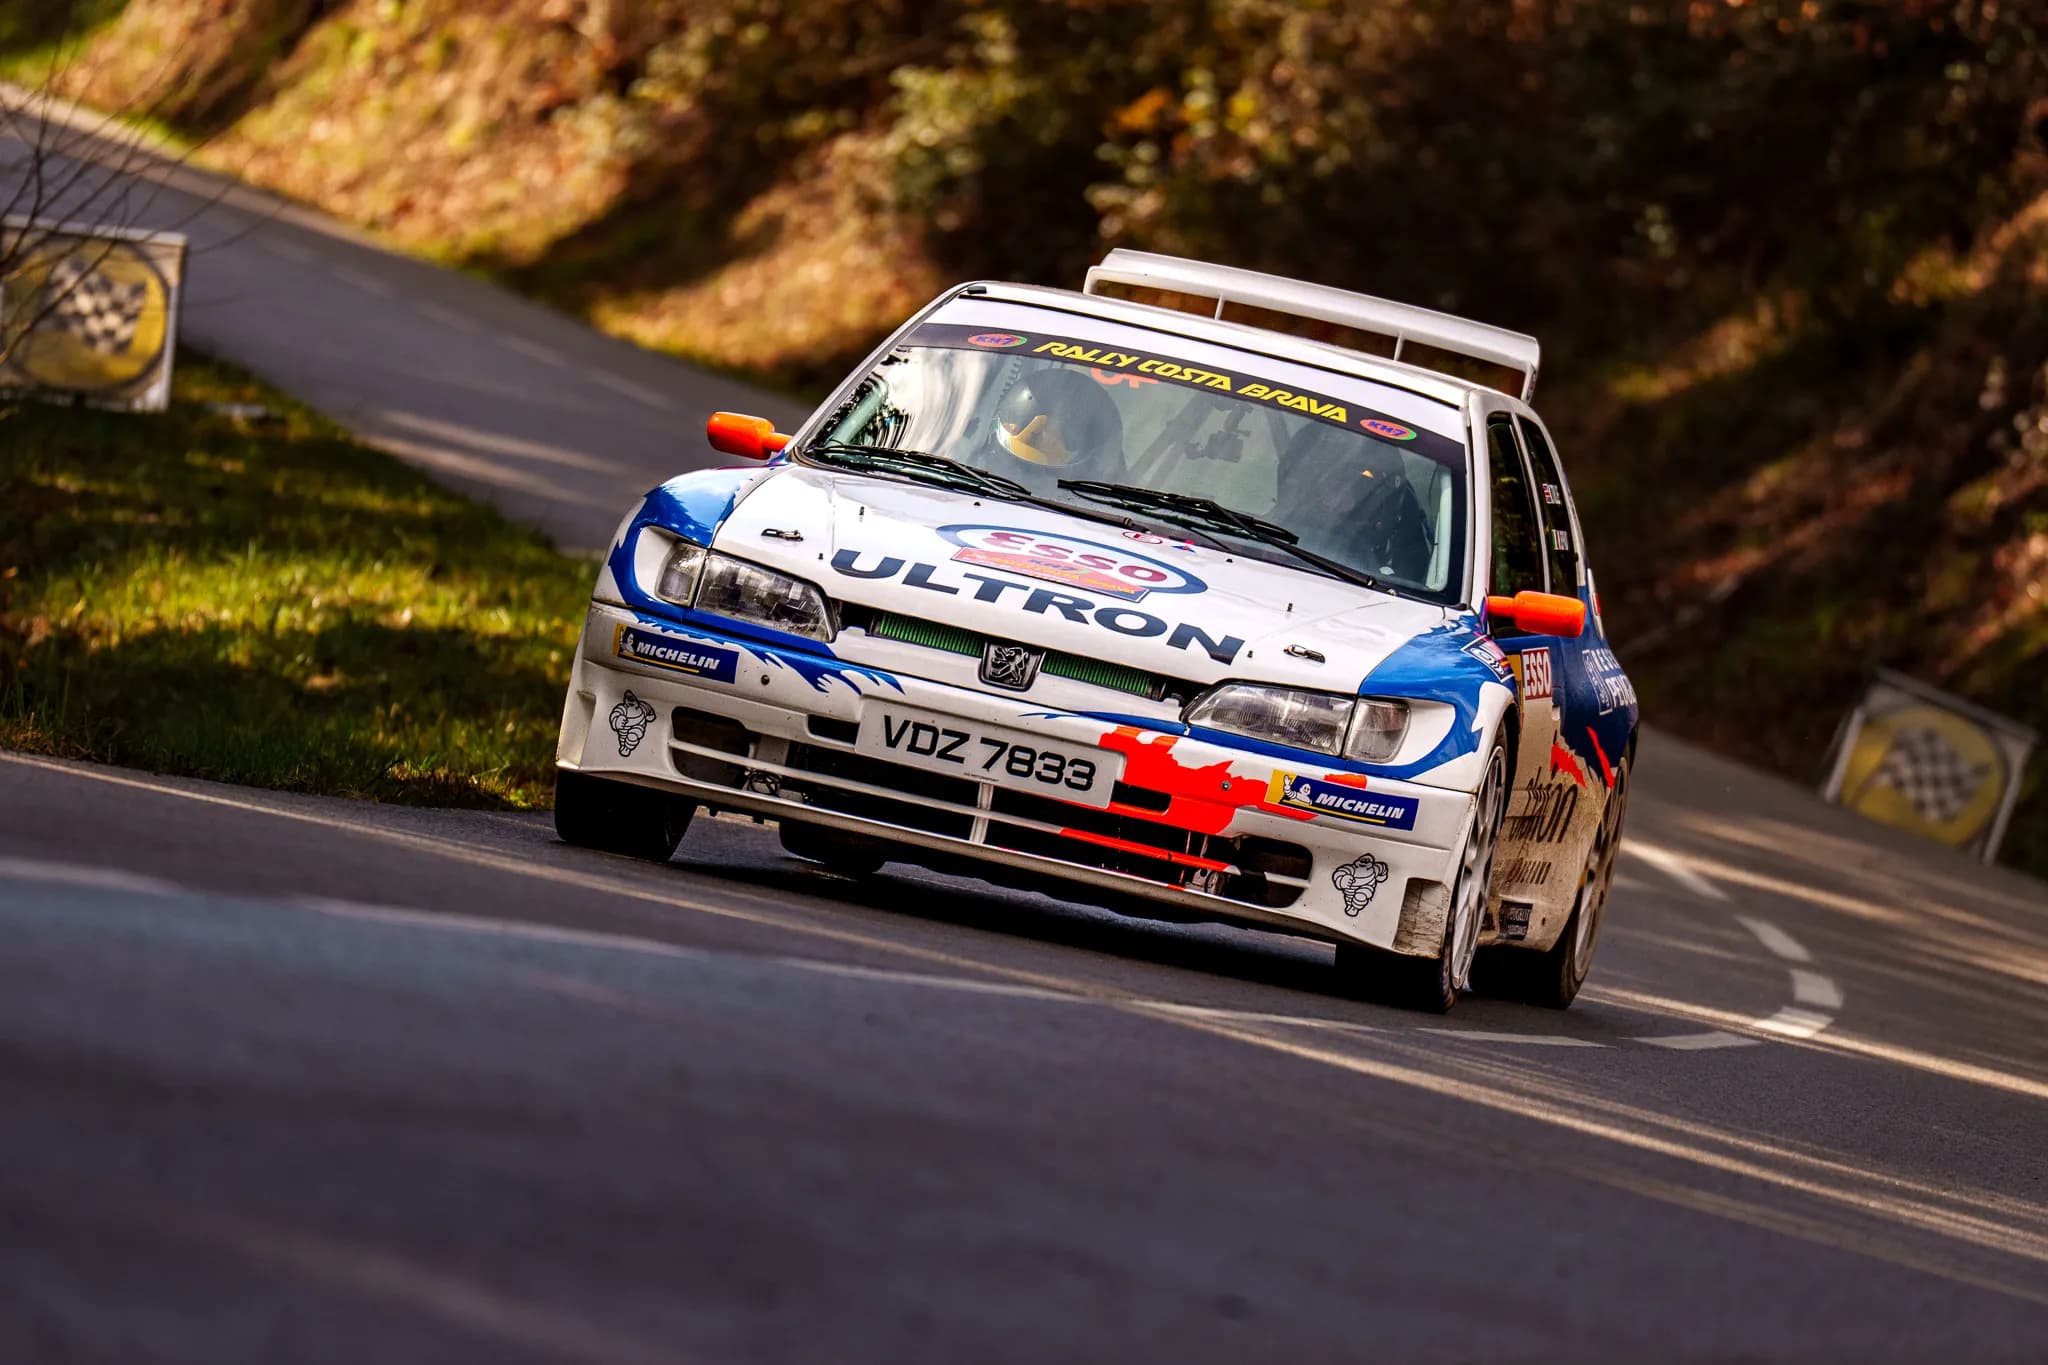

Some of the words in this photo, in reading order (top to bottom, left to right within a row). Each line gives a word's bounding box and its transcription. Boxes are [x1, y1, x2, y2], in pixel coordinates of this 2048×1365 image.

[1032, 341, 1140, 368] RALLY
[1137, 359, 1232, 391] COSTA
[1237, 383, 1348, 424] BRAVA
[1367, 420, 1407, 438] KH7
[981, 531, 1168, 583] ESSO
[830, 548, 1246, 666] ULTRON
[636, 641, 721, 671] MICHELIN
[1522, 650, 1552, 697] ESSO
[883, 714, 971, 765] VDZ
[980, 736, 1097, 792] 7833
[1315, 792, 1405, 820] MICHELIN
